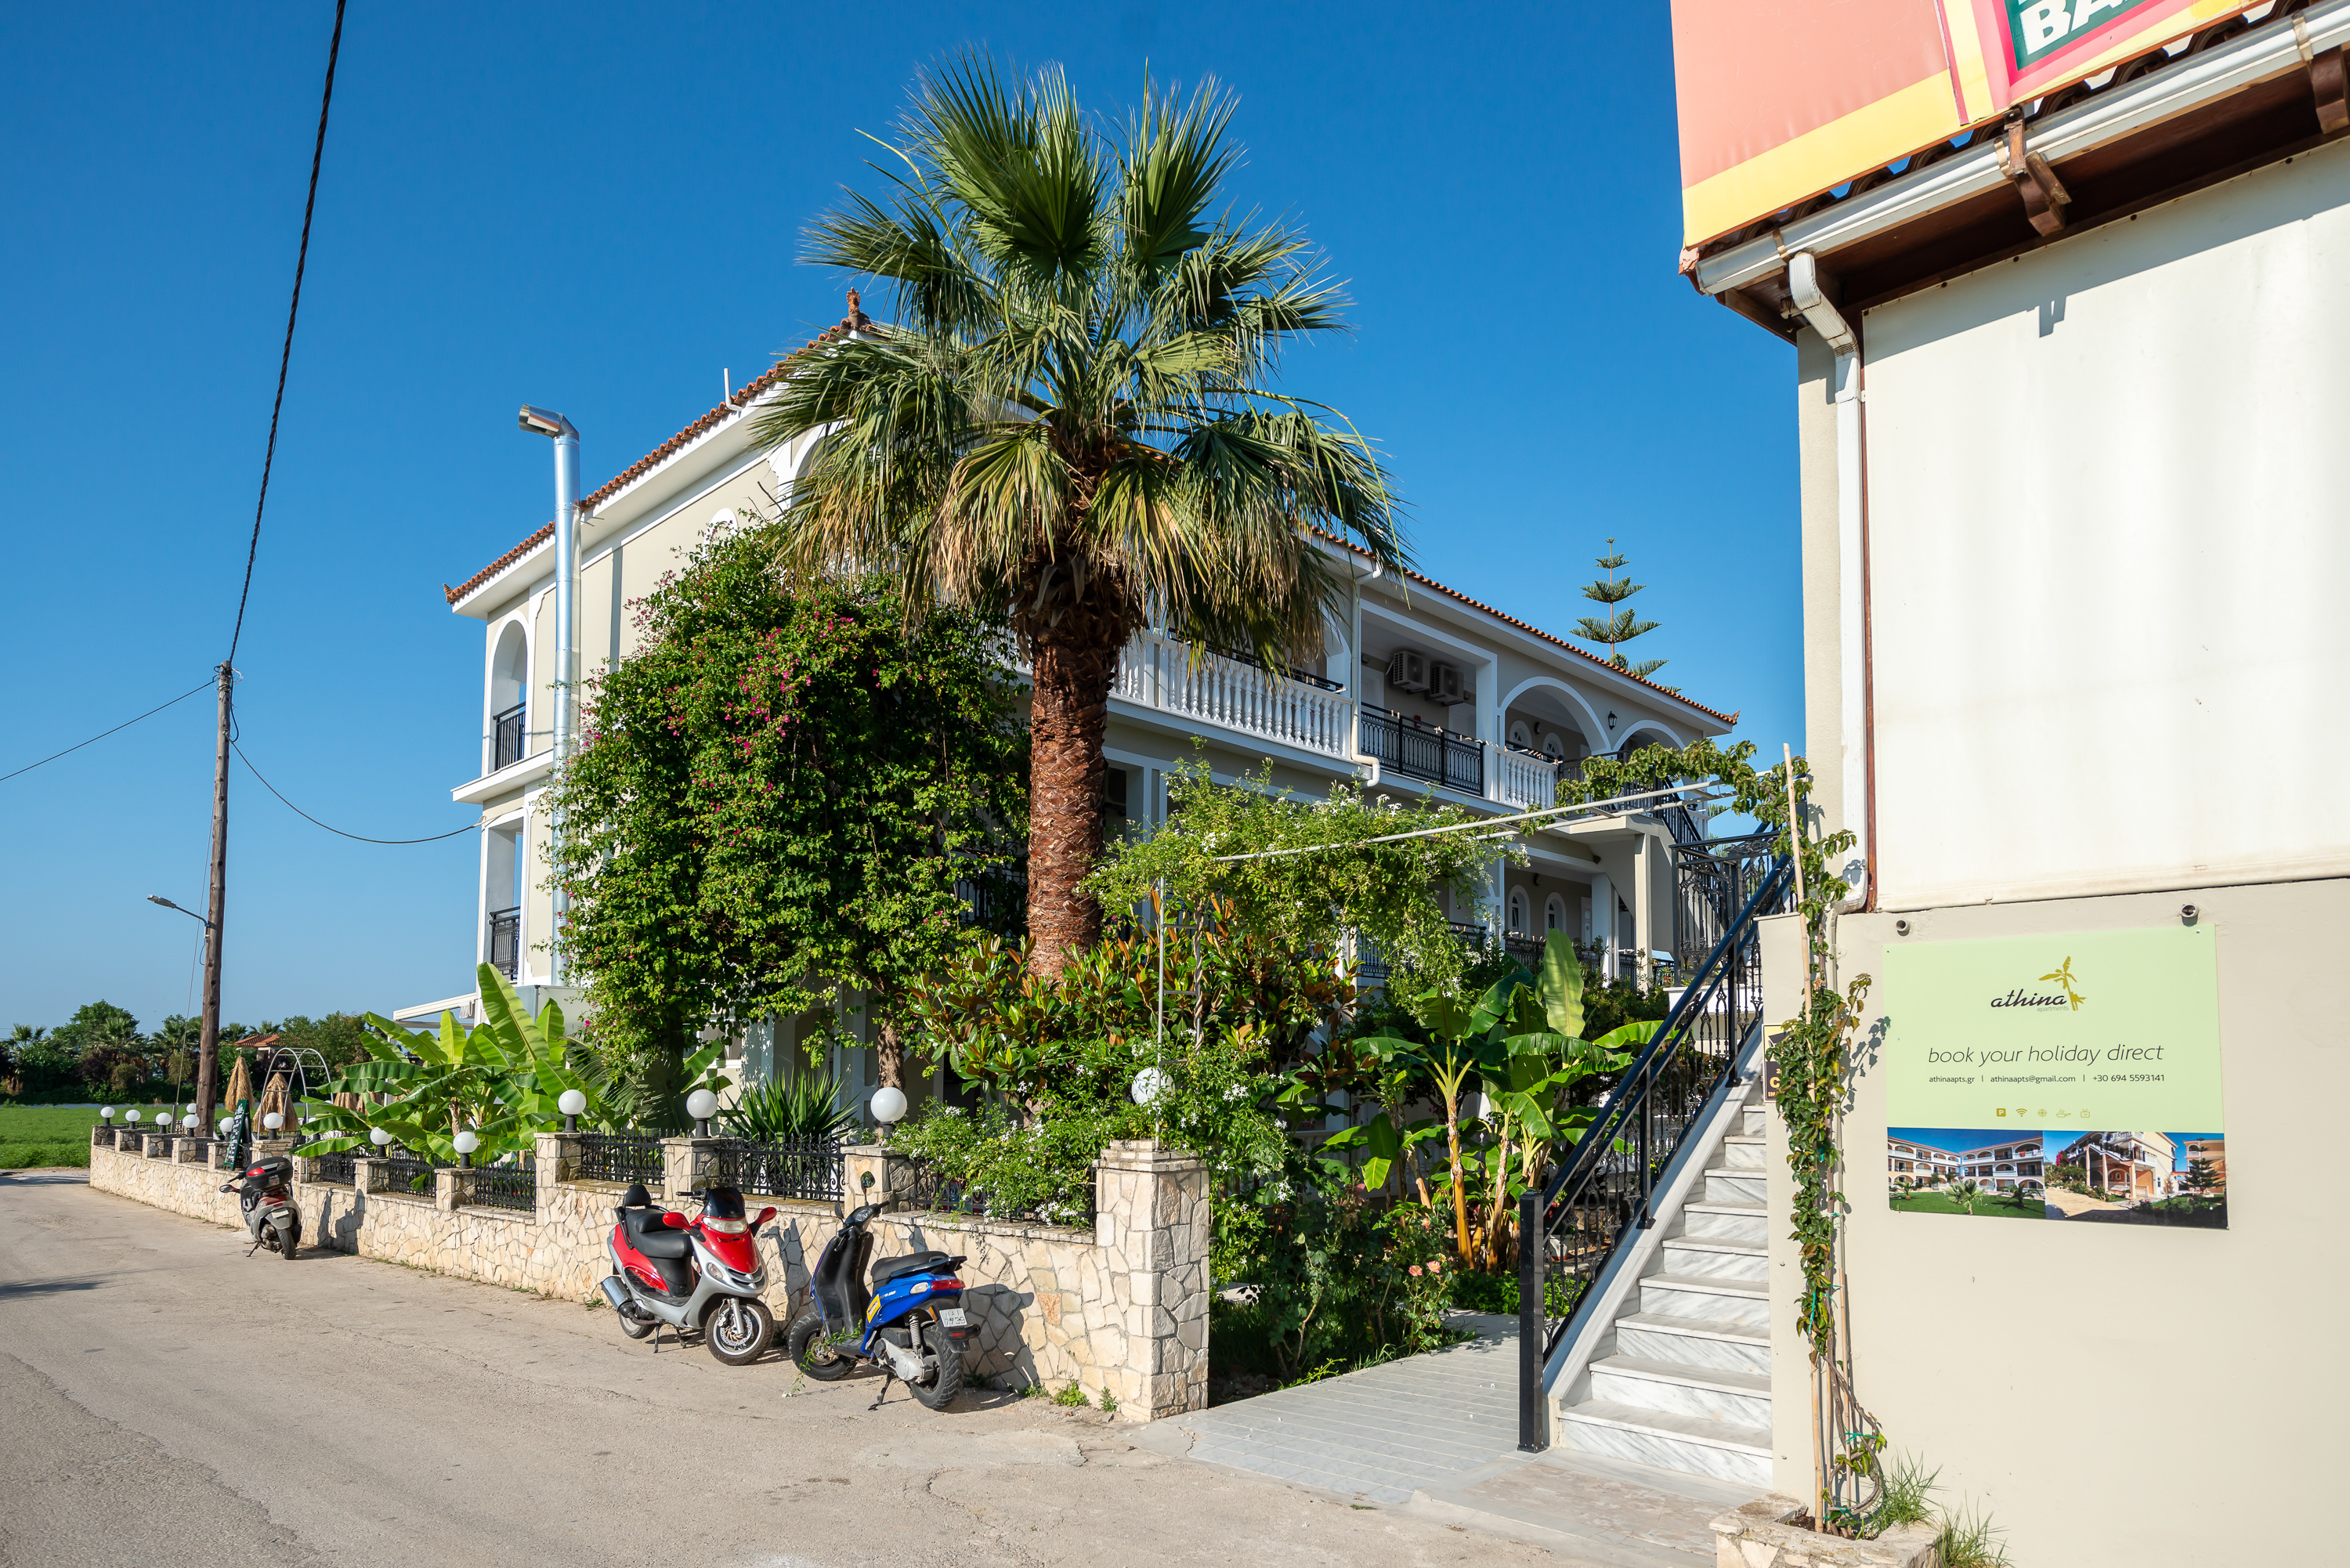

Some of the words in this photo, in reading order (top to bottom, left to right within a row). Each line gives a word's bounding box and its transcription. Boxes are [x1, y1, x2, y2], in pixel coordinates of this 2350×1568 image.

[1990, 988, 2067, 1007] athina
[1929, 1047, 1974, 1063] book
[1978, 1050, 2023, 1068] your
[2028, 1044, 2101, 1067] holiday
[2107, 1044, 2164, 1060] direct
[1929, 1075, 1975, 1084] athinaapts.gr
[1990, 1075, 2076, 1085] athinaapts@gmail.com
